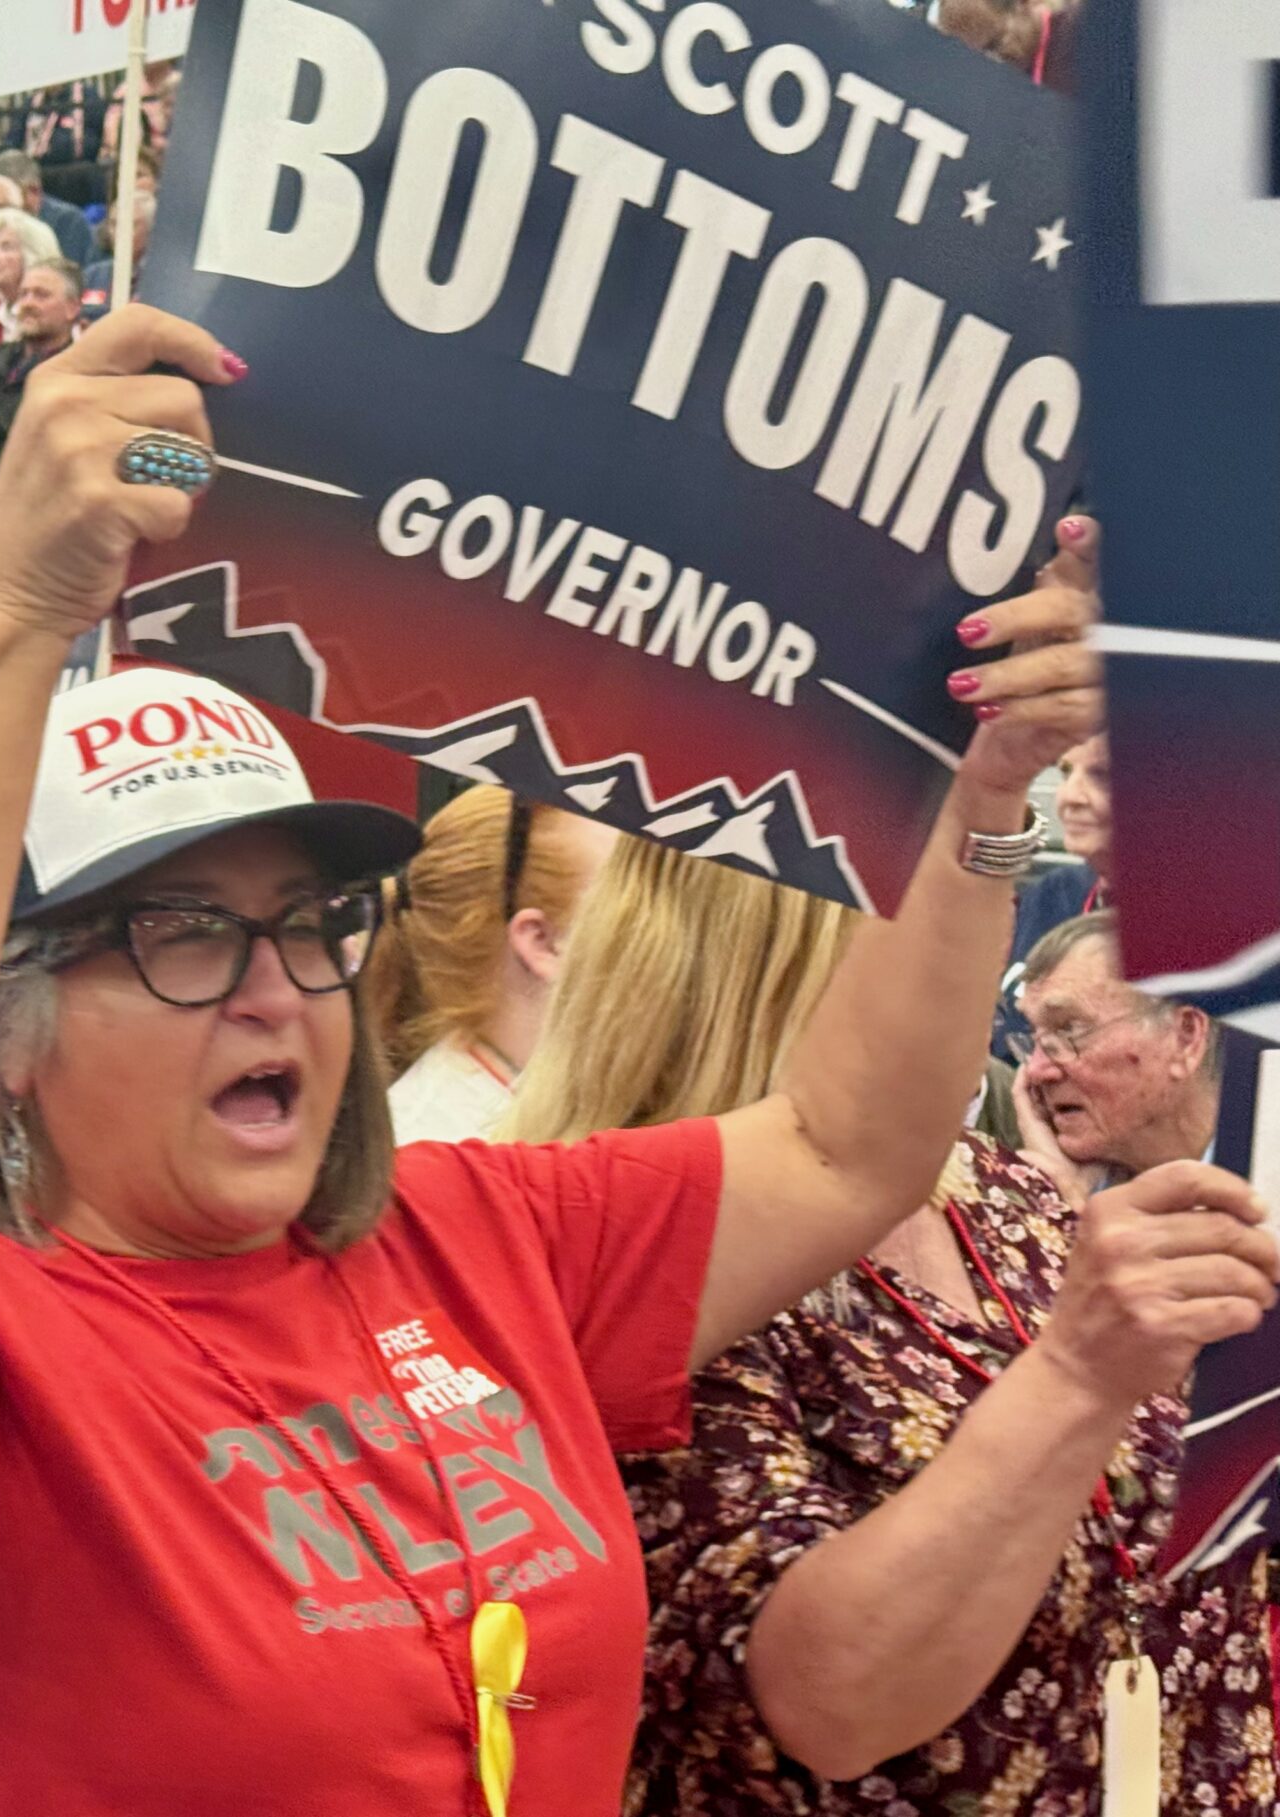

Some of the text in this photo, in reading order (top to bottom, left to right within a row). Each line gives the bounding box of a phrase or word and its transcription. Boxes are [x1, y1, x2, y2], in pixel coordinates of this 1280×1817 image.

[580, 0, 970, 225] SCOTT
[194, 0, 1081, 597] BOTTOMS
[377, 478, 817, 706] GOVERNOR
[65, 696, 275, 776] POND
[109, 774, 157, 800] FOR
[374, 1319, 434, 1359] FREE
